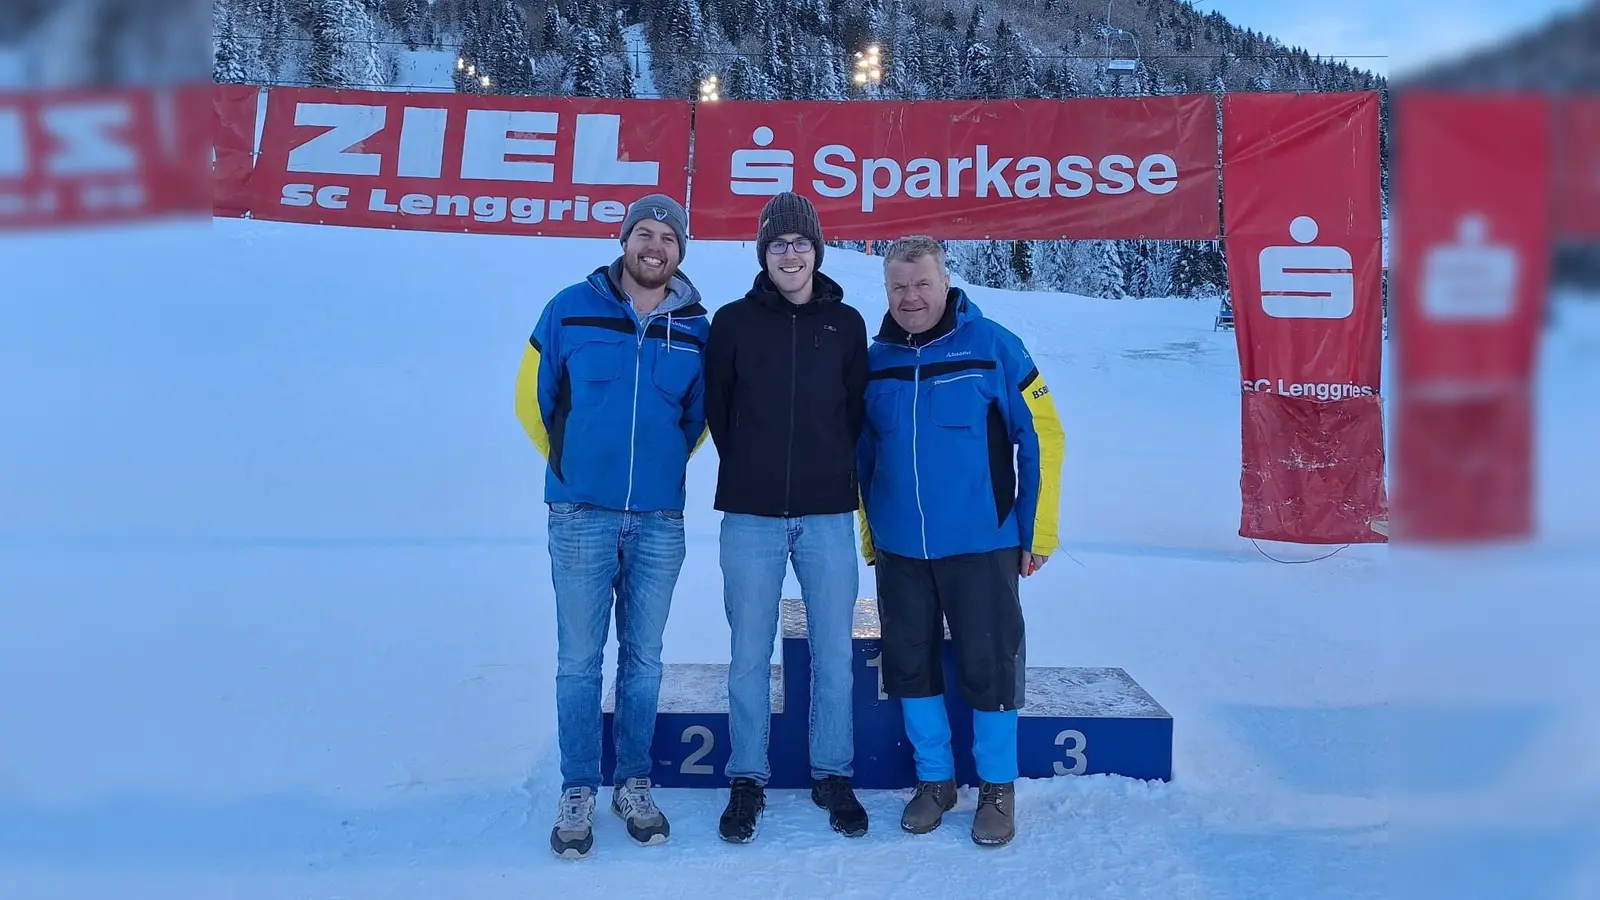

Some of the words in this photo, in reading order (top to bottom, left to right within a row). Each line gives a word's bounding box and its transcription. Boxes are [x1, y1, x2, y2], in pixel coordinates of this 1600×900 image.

[286, 101, 660, 187] ZIEL
[280, 182, 350, 210] SC
[368, 188, 634, 225] Lenggrie
[812, 144, 1179, 213] Sparkasse
[1243, 378, 1271, 393] SC
[1277, 378, 1373, 400] Lenggries
[866, 650, 889, 701] 1
[680, 725, 715, 775] 2
[1053, 729, 1088, 777] 3
